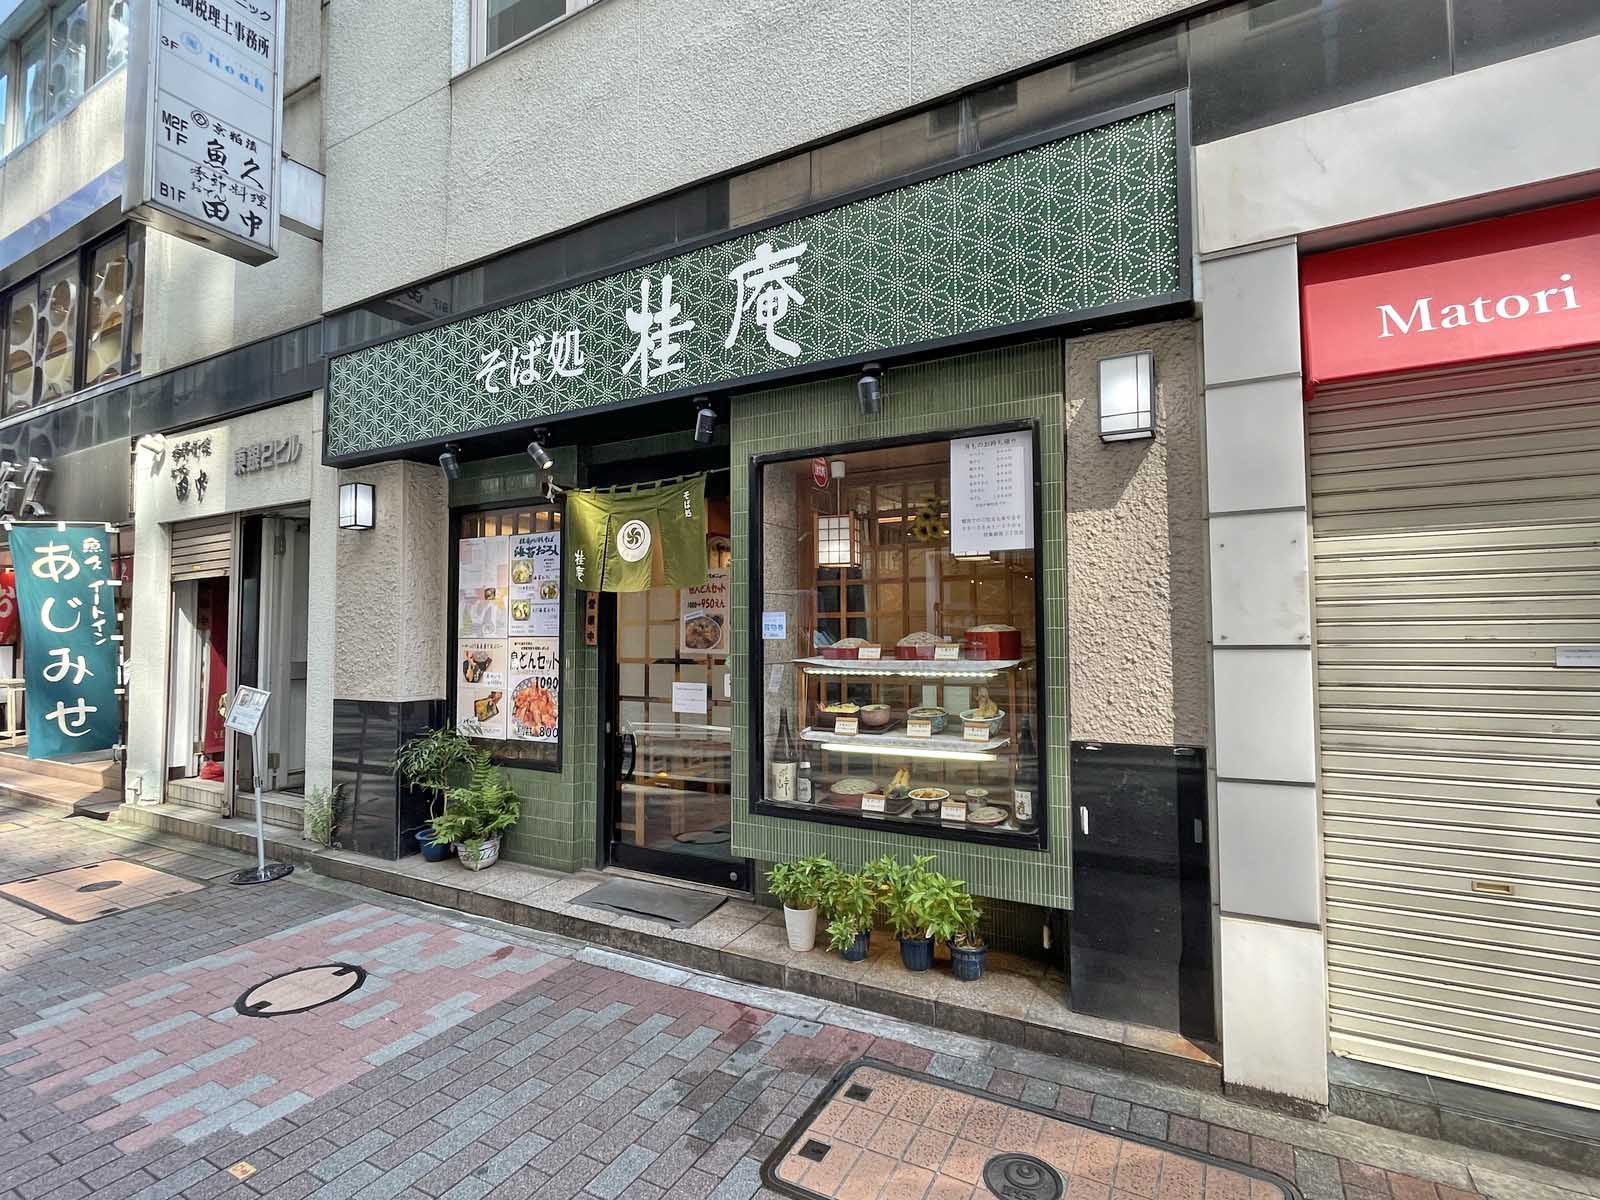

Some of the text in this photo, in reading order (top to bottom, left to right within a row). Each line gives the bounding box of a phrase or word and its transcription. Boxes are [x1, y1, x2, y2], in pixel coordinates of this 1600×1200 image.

[160, 35, 180, 50] 3F
[161, 109, 189, 132] M2F
[164, 126, 188, 146] 1F
[160, 181, 187, 203] B1F
[202, 200, 263, 238] 田中
[475, 241, 808, 394] そば処 桂庵
[1376, 273, 1581, 339] Matori
[88, 580, 107, 646] イートイン
[31, 540, 98, 737] あじみせ
